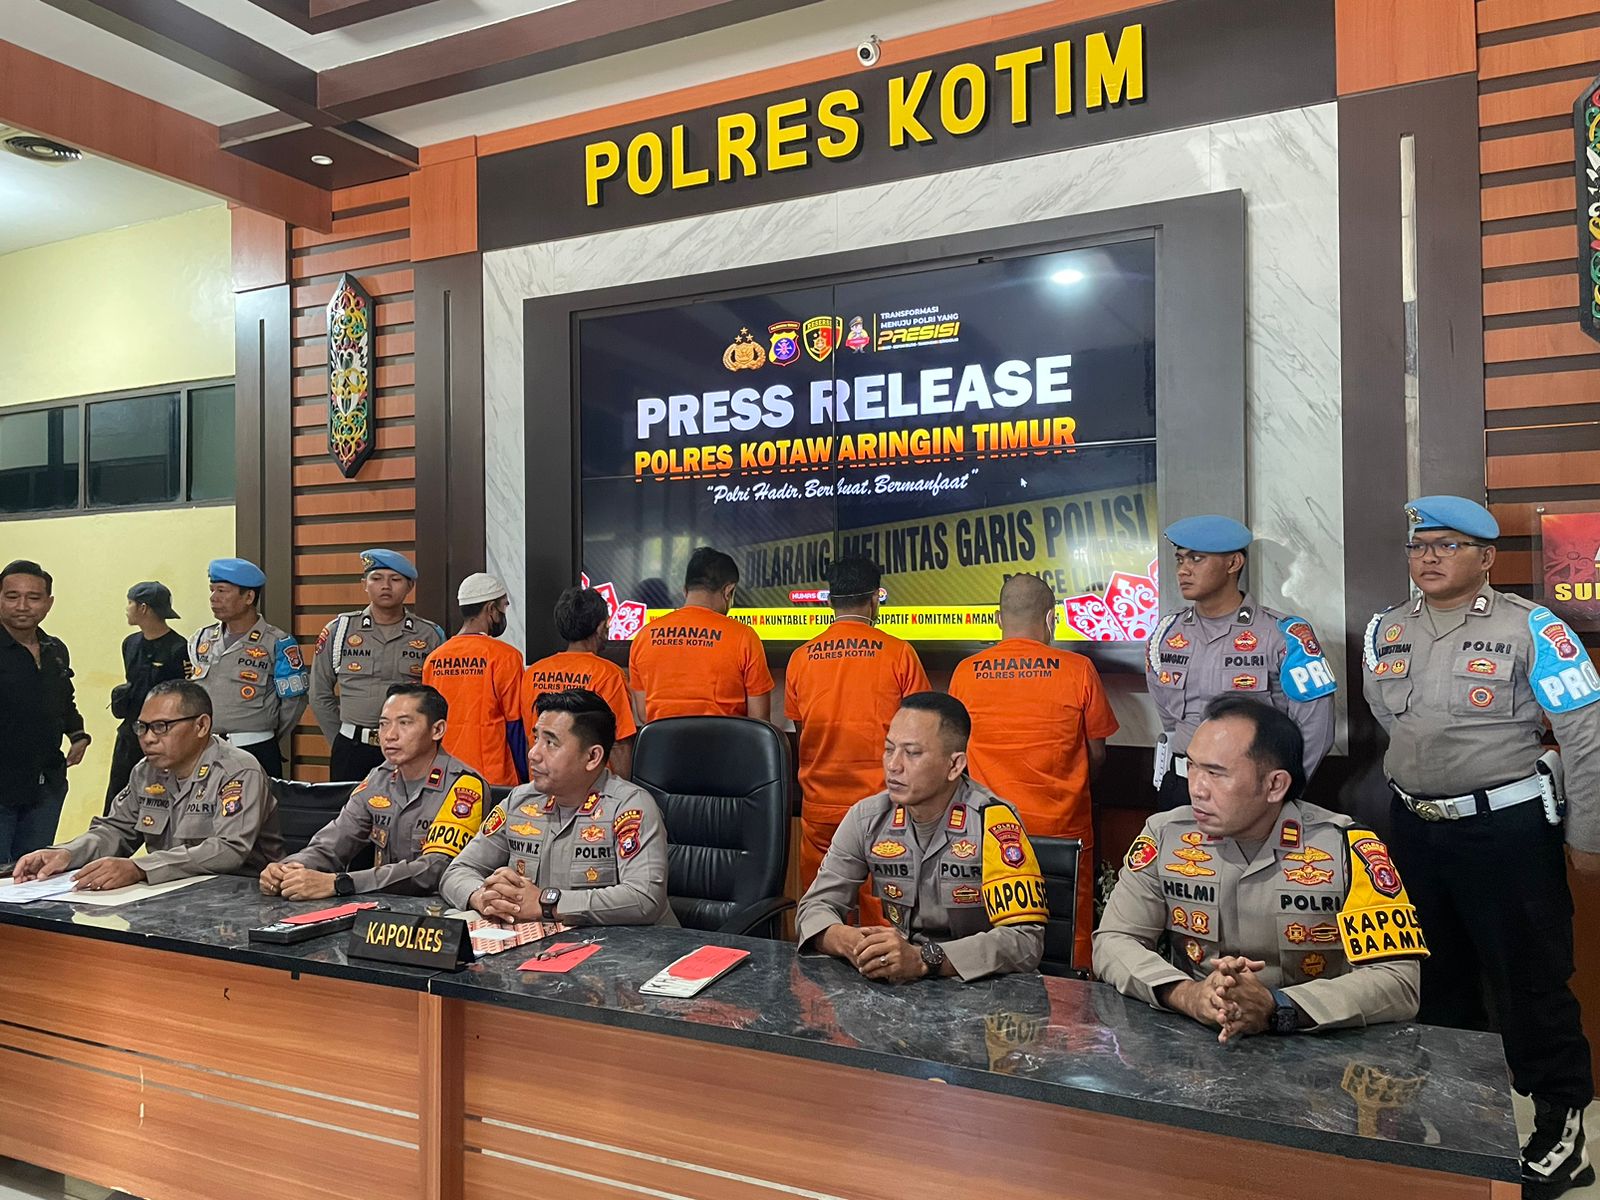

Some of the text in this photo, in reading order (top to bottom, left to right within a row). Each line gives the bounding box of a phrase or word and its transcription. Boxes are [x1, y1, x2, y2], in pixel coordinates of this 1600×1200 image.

[585, 23, 1145, 207] POLRES KOTIM
[880, 306, 939, 320] TRANSFORMASI
[880, 313, 959, 329] MENUJU POLRI YANG
[878, 321, 960, 345] PRESISI
[636, 354, 1072, 440] PRESS RELEASE
[635, 416, 1077, 482] POLRES KOTAWARINGIN TIMUR
[752, 481, 802, 500] Hadir,
[745, 538, 832, 590] DILARANG
[956, 508, 1036, 568] GARIS
[1042, 493, 1151, 559] POLISI
[791, 592, 818, 601] HUMAS
[759, 614, 808, 627] AKUNTABLE
[911, 613, 963, 625] KOMITMEN
[650, 626, 723, 641] TAHANAN
[651, 638, 714, 648] POLRES KOTIM
[806, 638, 884, 654] TAHANAN
[1462, 640, 1513, 654] POLRI
[808, 649, 876, 661] POLRES KOTIM
[1224, 654, 1265, 667] POLRI
[237, 657, 269, 670] POLRI
[430, 657, 488, 669] TAHANAN
[972, 657, 1061, 672] TAHANAN
[433, 668, 484, 677] POLRES KOTIM
[532, 671, 593, 685] TAHANAN
[975, 670, 1053, 680] POLRES KOTIM
[575, 846, 612, 859] POLRI
[874, 863, 909, 877] ANIS
[1163, 880, 1216, 903] HELMI
[1280, 894, 1341, 911] POLRI
[365, 920, 445, 954] KAPOLRES
